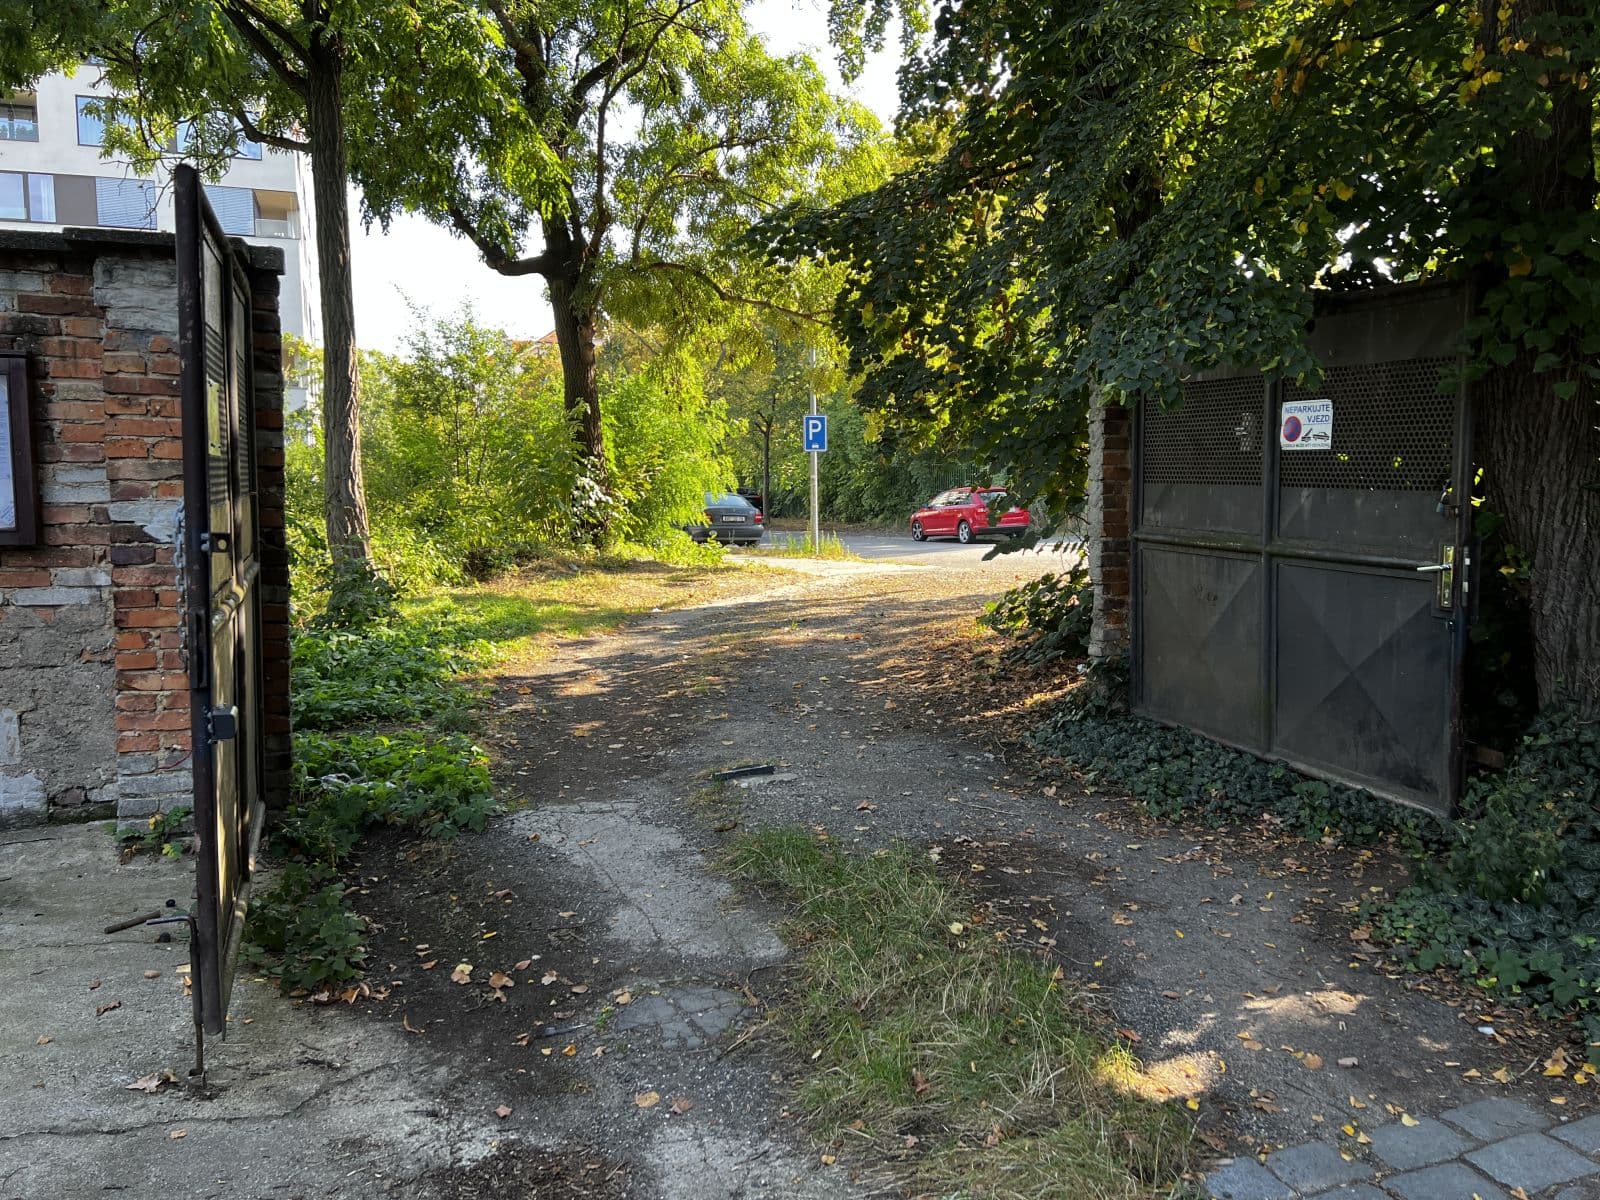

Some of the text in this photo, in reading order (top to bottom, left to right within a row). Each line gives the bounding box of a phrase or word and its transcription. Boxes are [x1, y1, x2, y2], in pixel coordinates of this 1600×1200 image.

[1285, 404, 1330, 413] NEPARKUJTE
[1308, 415, 1330, 423] VJEZD
[809, 420, 822, 441] P
